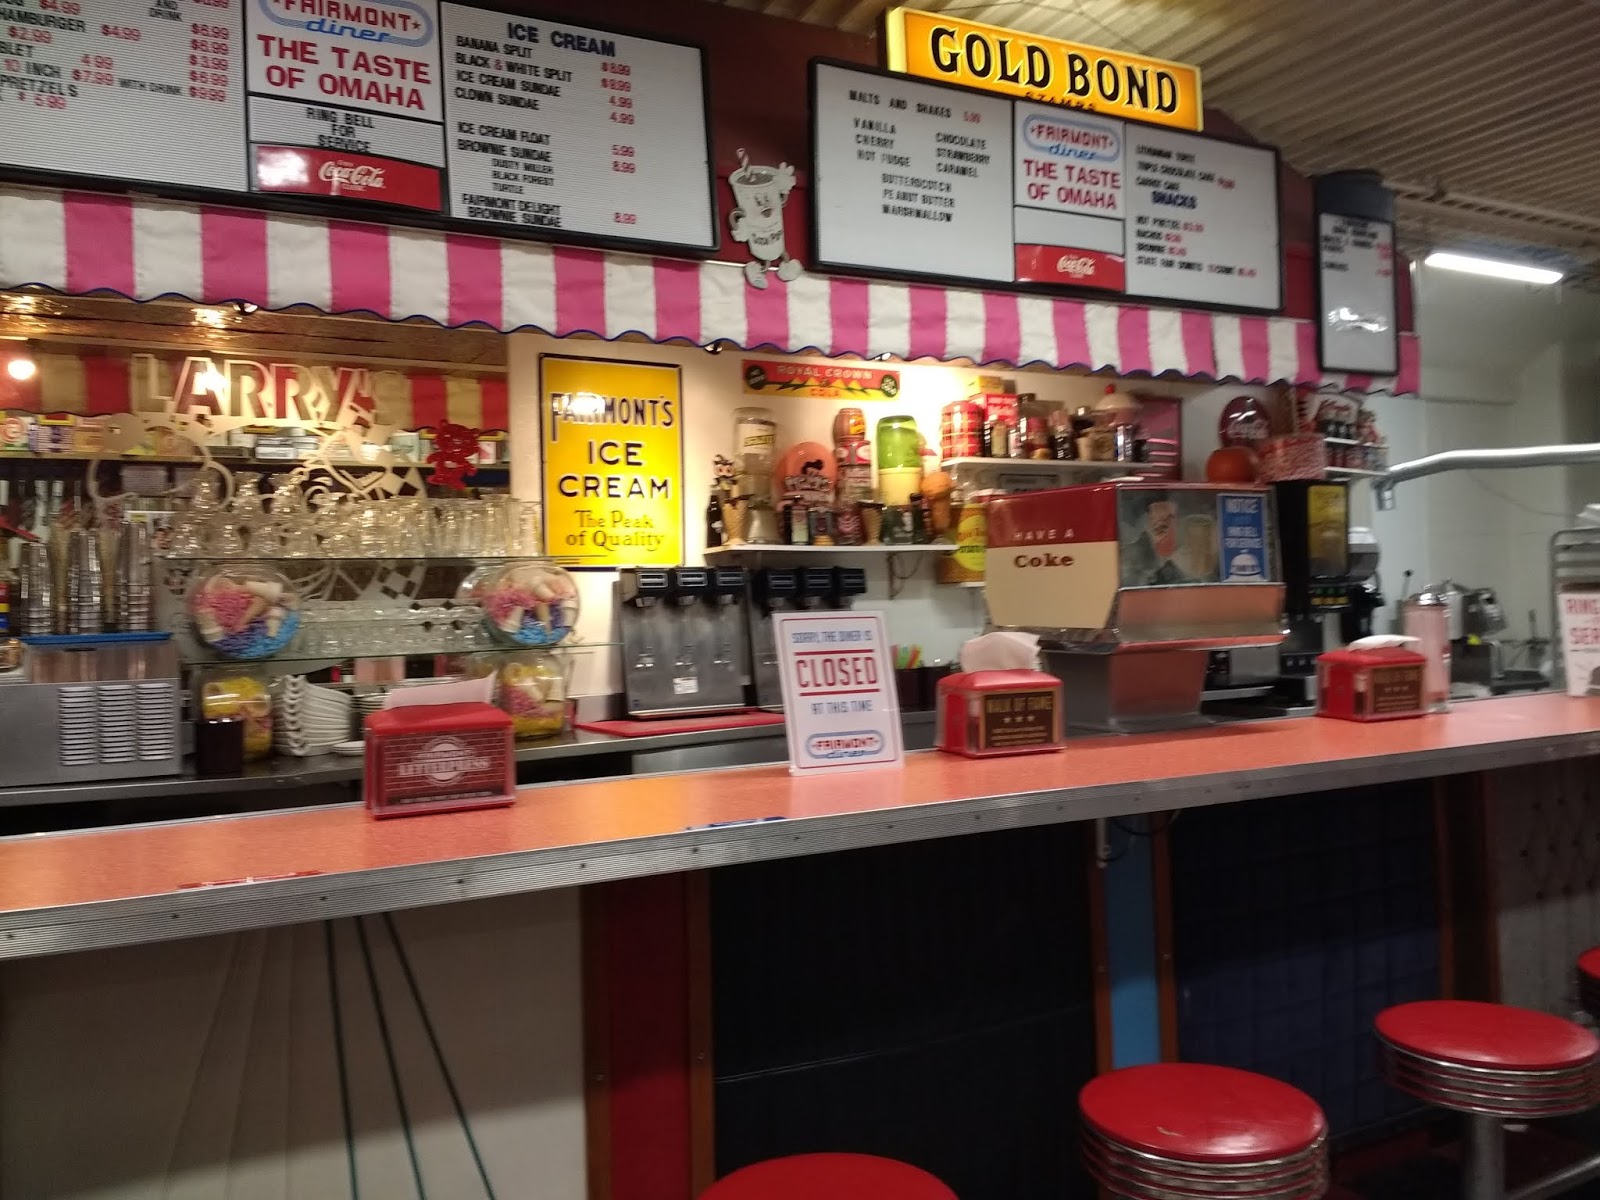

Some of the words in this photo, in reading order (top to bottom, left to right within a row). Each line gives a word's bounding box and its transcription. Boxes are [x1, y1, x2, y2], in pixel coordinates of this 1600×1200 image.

[284, 0, 412, 31] FAIRMONT
[305, 18, 391, 42] diner
[507, 22, 540, 43] ICE
[551, 31, 616, 57] CREAM
[456, 35, 500, 53] BANANA
[503, 43, 533, 58] SPLIT
[26, 61, 62, 78] INCH
[257, 34, 319, 65] THE
[331, 46, 432, 84] TASTE
[455, 52, 490, 68] BLACK
[506, 61, 540, 77] WHITE
[544, 67, 573, 82] SPLIT
[931, 25, 1050, 89] GOLD
[1065, 52, 1177, 114] BOND
[266, 65, 305, 89] OF
[319, 73, 425, 110] OMAHA
[456, 70, 475, 84] ICE
[479, 73, 516, 90] CREAM
[521, 80, 561, 97] SUNDAE
[454, 87, 493, 103] CLOWN
[498, 93, 540, 111] SUNDAE
[849, 89, 880, 105] MALTS
[889, 98, 908, 110] AND
[306, 107, 337, 123] RING
[344, 113, 375, 129] BELL
[331, 124, 355, 138] FOR
[457, 121, 475, 135] ICE
[478, 124, 517, 141] CREAM
[520, 130, 551, 146] FLOAT
[853, 117, 896, 134] VANILLA
[935, 132, 987, 150] CHOCOLATE
[1036, 124, 1109, 150] FAIRMONT
[318, 134, 372, 153] SERVICE
[457, 139, 507, 157] BROWNIE
[510, 146, 552, 162] SUNDAE
[855, 133, 895, 149] CHERRY
[935, 147, 991, 165] STRAWBERRY
[1049, 143, 1097, 160] diner
[318, 160, 386, 189] Coca-Cola
[856, 149, 876, 162] HOT
[880, 153, 911, 168] FUDGE
[936, 162, 979, 178] CARAMEL
[1024, 159, 1058, 179] THE
[1065, 165, 1121, 190] TASTE
[492, 170, 520, 183] BLACK
[1028, 183, 1050, 200] OF
[1057, 186, 1117, 210] OMAHA
[468, 206, 517, 223] BROWNIE
[881, 204, 954, 223] MARSHMALLOW
[776, 365, 823, 377] ROYAL
[825, 368, 873, 380] CROWN
[589, 441, 643, 466] ICE
[559, 476, 669, 499] CREAM
[574, 510, 605, 528] The
[612, 511, 653, 528] Peak
[566, 532, 587, 547] of
[593, 531, 664, 552] Quality
[1013, 528, 1057, 542] HAVE
[1064, 527, 1075, 539] A
[1014, 553, 1074, 568] Coke
[822, 631, 837, 643] THE
[796, 656, 877, 688] CLOSED
[812, 703, 824, 714] AT
[826, 702, 848, 713] THIS
[851, 700, 873, 711] TIME
[816, 737, 875, 750] FAIRMONT
